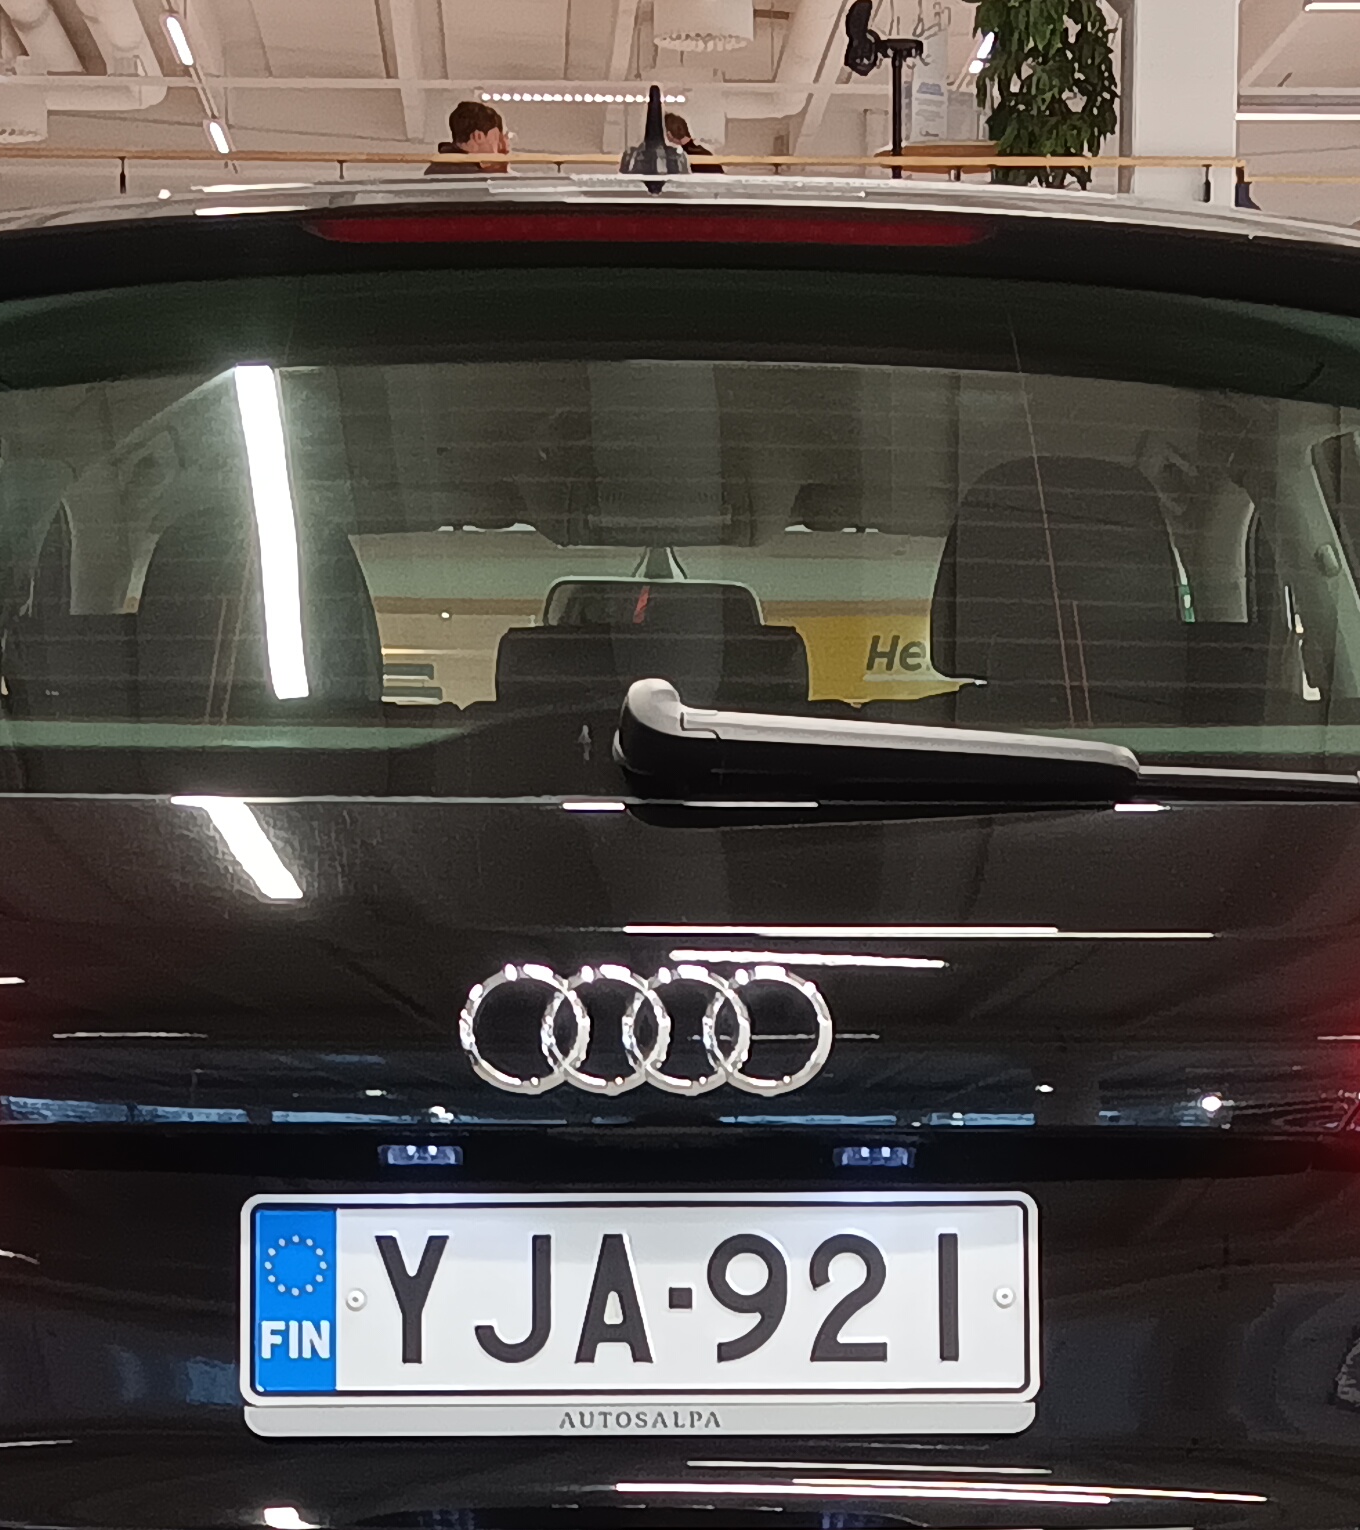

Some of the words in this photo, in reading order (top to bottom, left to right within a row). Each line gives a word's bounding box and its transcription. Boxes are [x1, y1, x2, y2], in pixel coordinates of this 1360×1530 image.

[866, 634, 931, 672] He
[375, 1233, 960, 1364] YJA-921
[260, 1320, 331, 1360] FIN
[559, 1411, 721, 1429] AUTOSALPA
